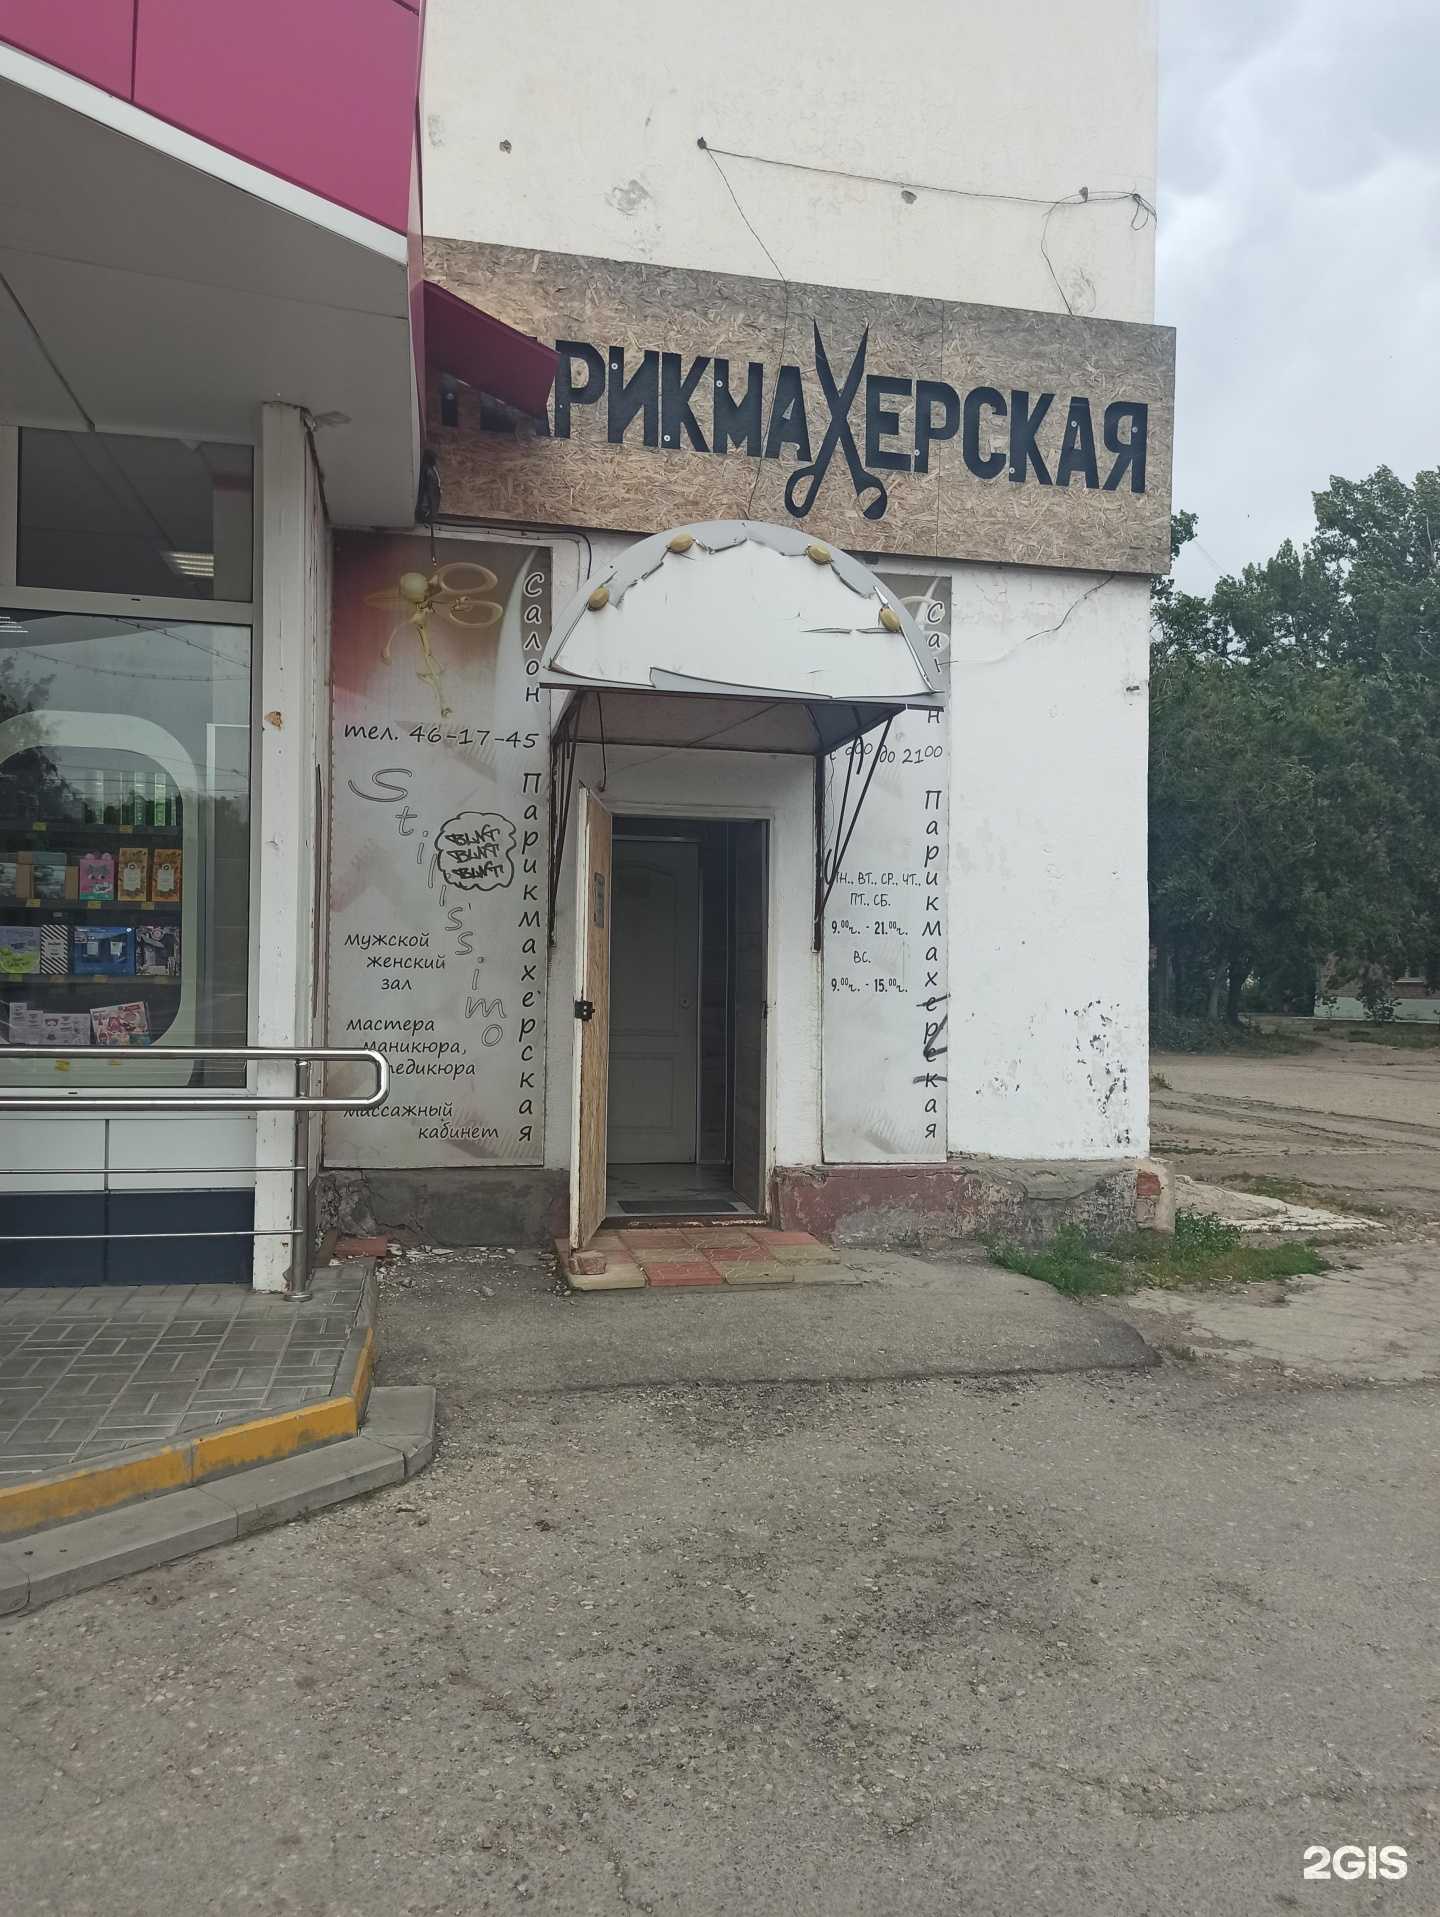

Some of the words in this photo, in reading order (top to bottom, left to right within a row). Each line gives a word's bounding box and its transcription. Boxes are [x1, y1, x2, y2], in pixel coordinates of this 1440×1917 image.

[440, 317, 1148, 519] РИКМАХЕРСКАЯ
[523, 573, 544, 703] Салон
[926, 602, 944, 724] Сан
[344, 724, 398, 741] тел.
[409, 726, 540, 749] 46-17-45
[873, 893, 891, 907] СБ.
[344, 932, 430, 950] мужской
[366, 953, 446, 969] женский
[518, 773, 543, 1142] Парикмахерская
[853, 950, 871, 964] ВС.
[381, 978, 412, 990] зал
[346, 1018, 435, 1037] мастера
[418, 1121, 499, 1140] кабинет
